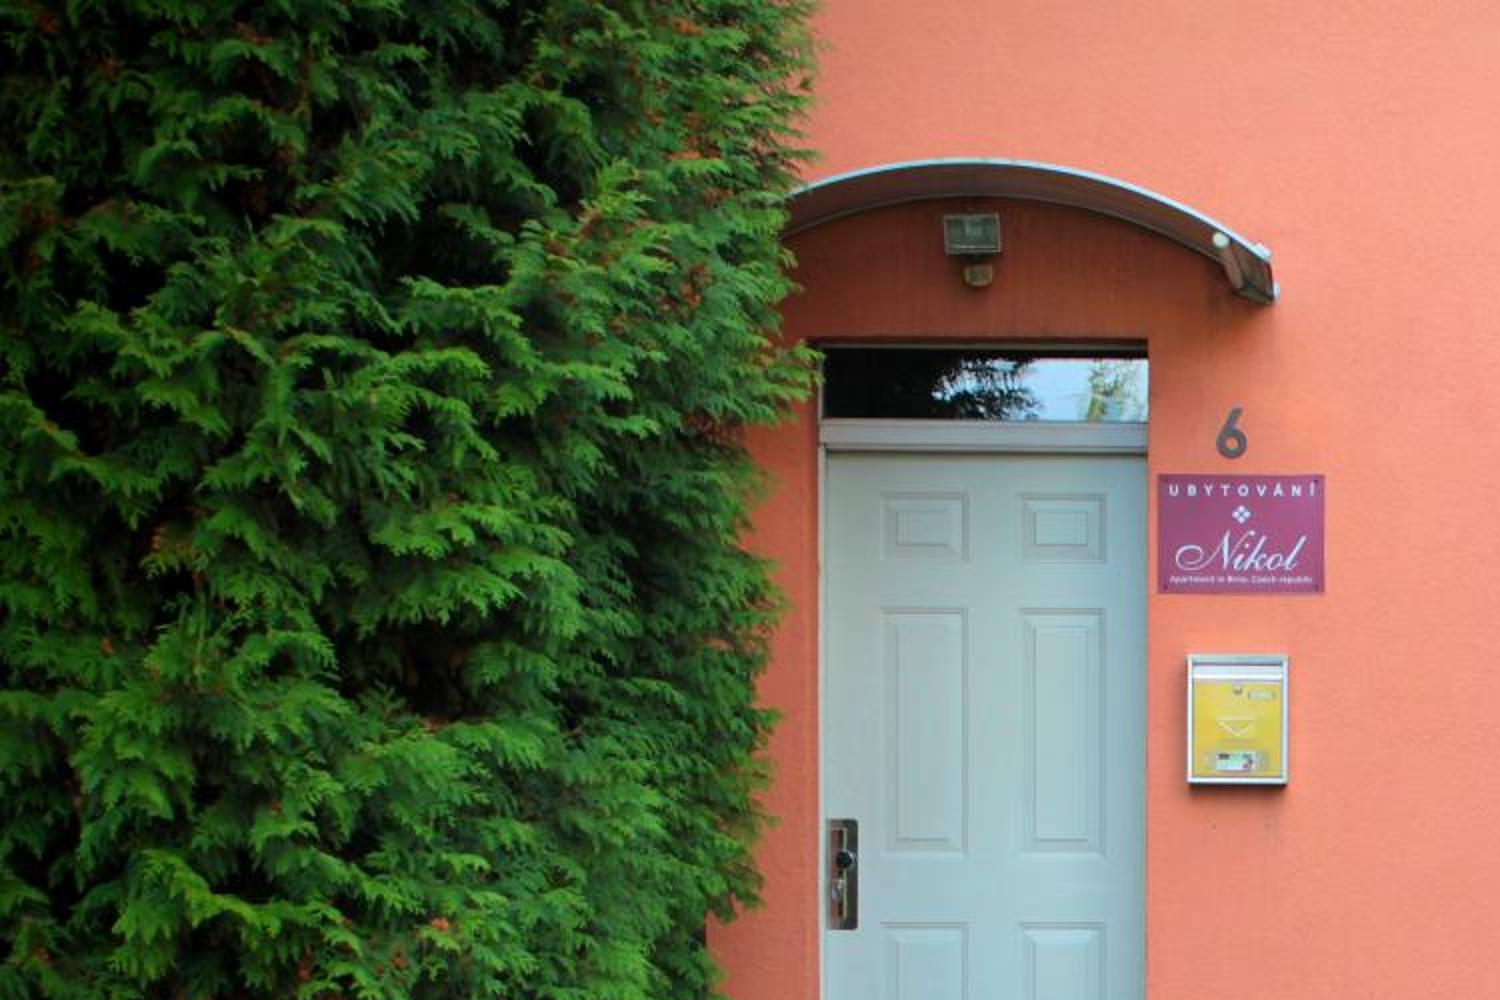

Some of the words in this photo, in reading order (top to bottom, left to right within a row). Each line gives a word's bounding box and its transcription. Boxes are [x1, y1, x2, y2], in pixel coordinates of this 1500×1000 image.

[1216, 407, 1247, 459] 6
[1169, 482, 1315, 496] UBYTOVÁNÍ
[1175, 529, 1307, 571] Nikol
